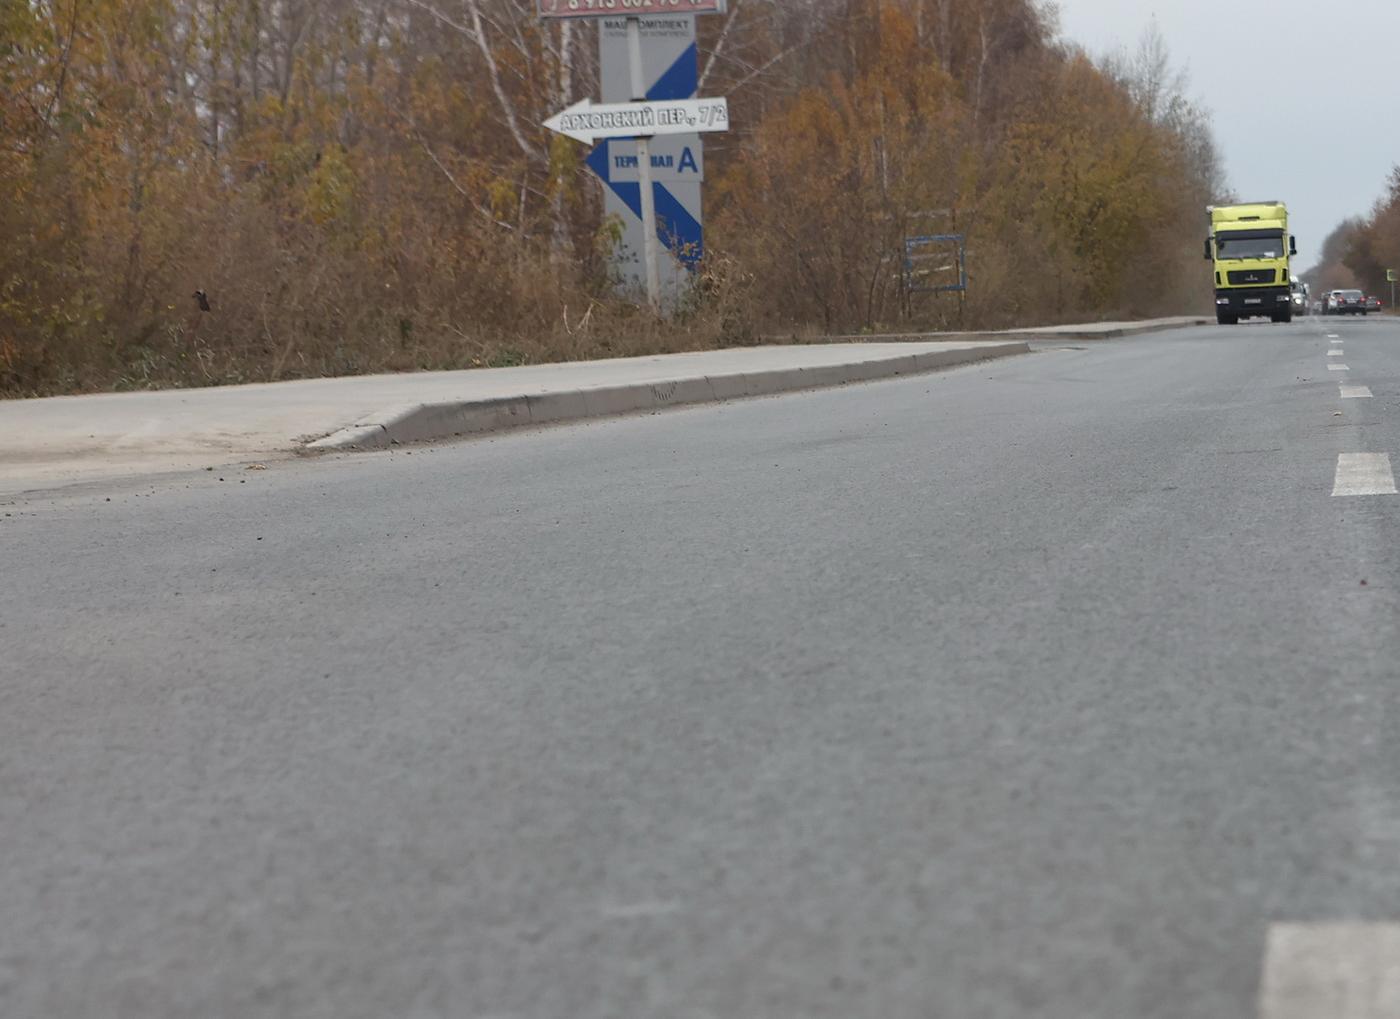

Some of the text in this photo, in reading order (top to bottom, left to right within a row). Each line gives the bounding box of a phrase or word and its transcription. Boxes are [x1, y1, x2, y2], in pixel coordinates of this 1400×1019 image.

[560, 106, 654, 131] АРХОНСКИЙ
[698, 104, 727, 127] 7/2
[614, 155, 674, 168] ТЕРМНАЛ
